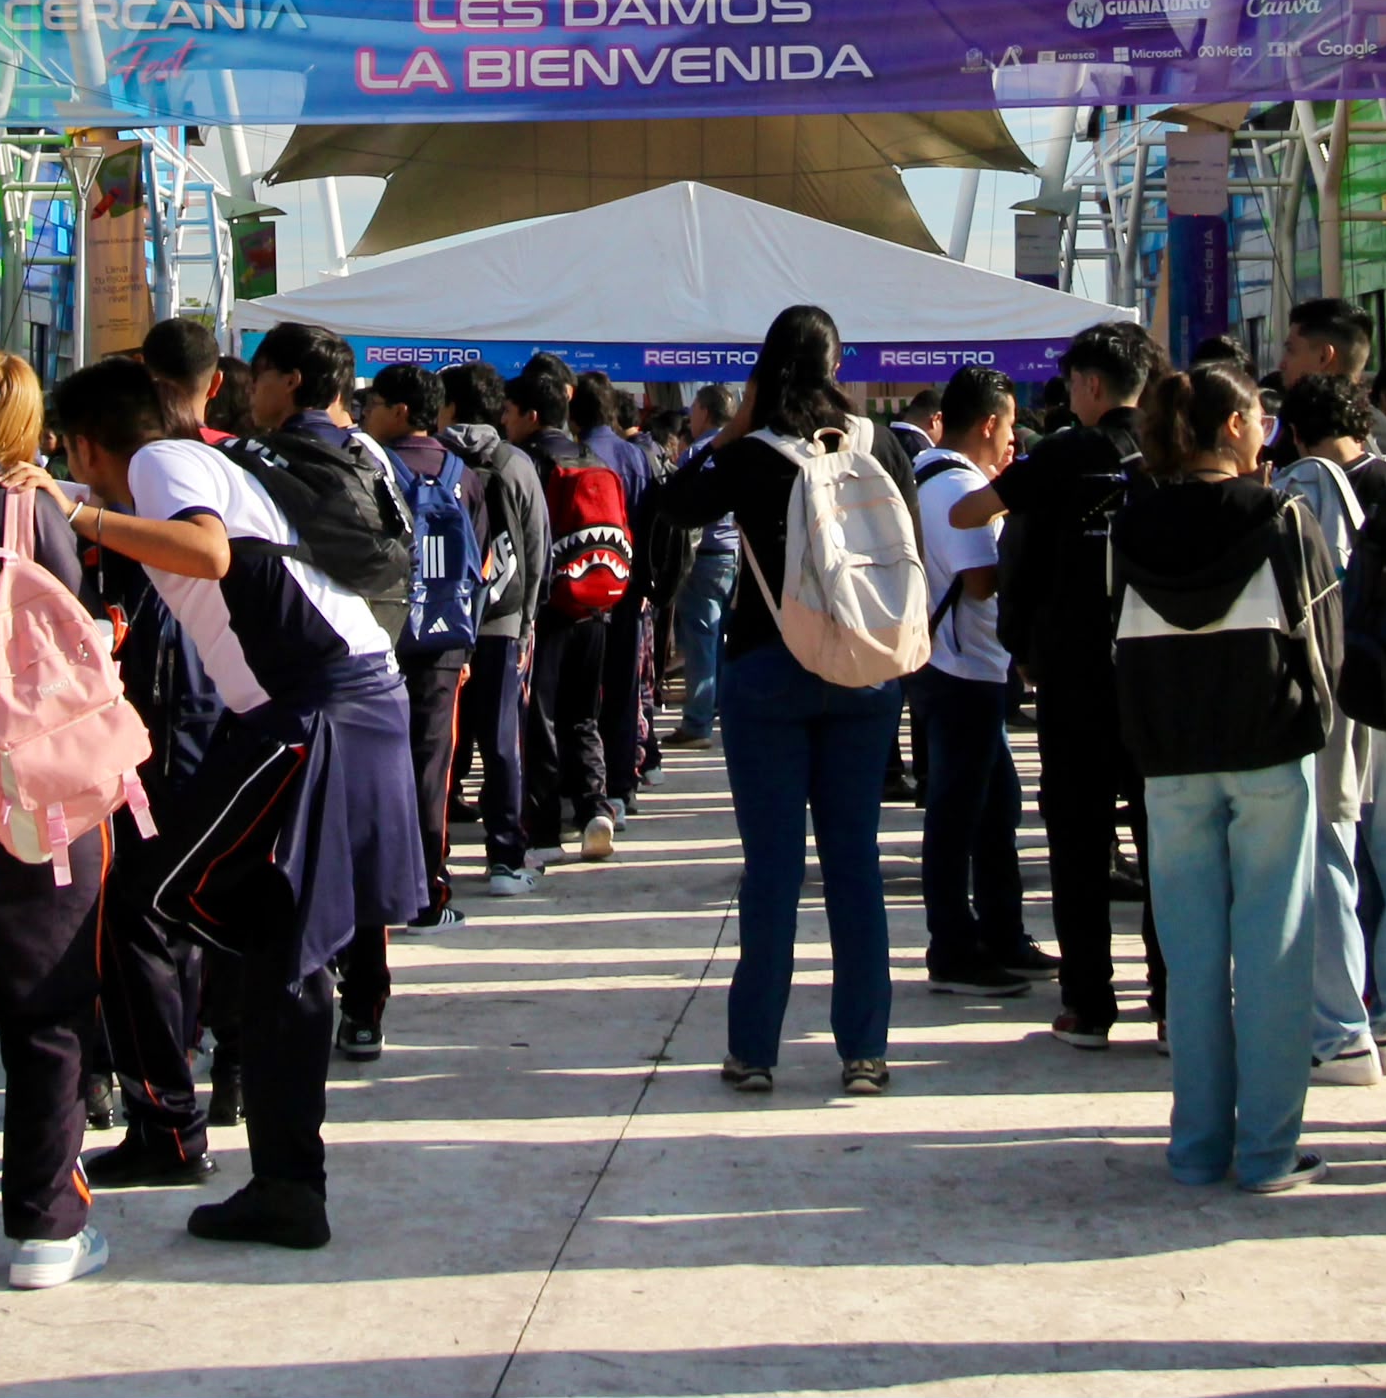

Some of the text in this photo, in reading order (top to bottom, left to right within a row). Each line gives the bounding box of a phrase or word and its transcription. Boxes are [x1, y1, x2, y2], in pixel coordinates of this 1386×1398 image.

[1058, 52, 1096, 61] unesco
[1131, 47, 1183, 59] Microsoft
[1217, 45, 1252, 57] Meta
[1267, 41, 1302, 58] IBM
[1317, 39, 1378, 60] Google
[106, 36, 213, 85] Fest
[360, 43, 874, 89] LA BIENVENIDA
[366, 347, 481, 363] REGISTRO
[644, 350, 758, 365] REGISTRO
[881, 350, 995, 366] REGISTRO
